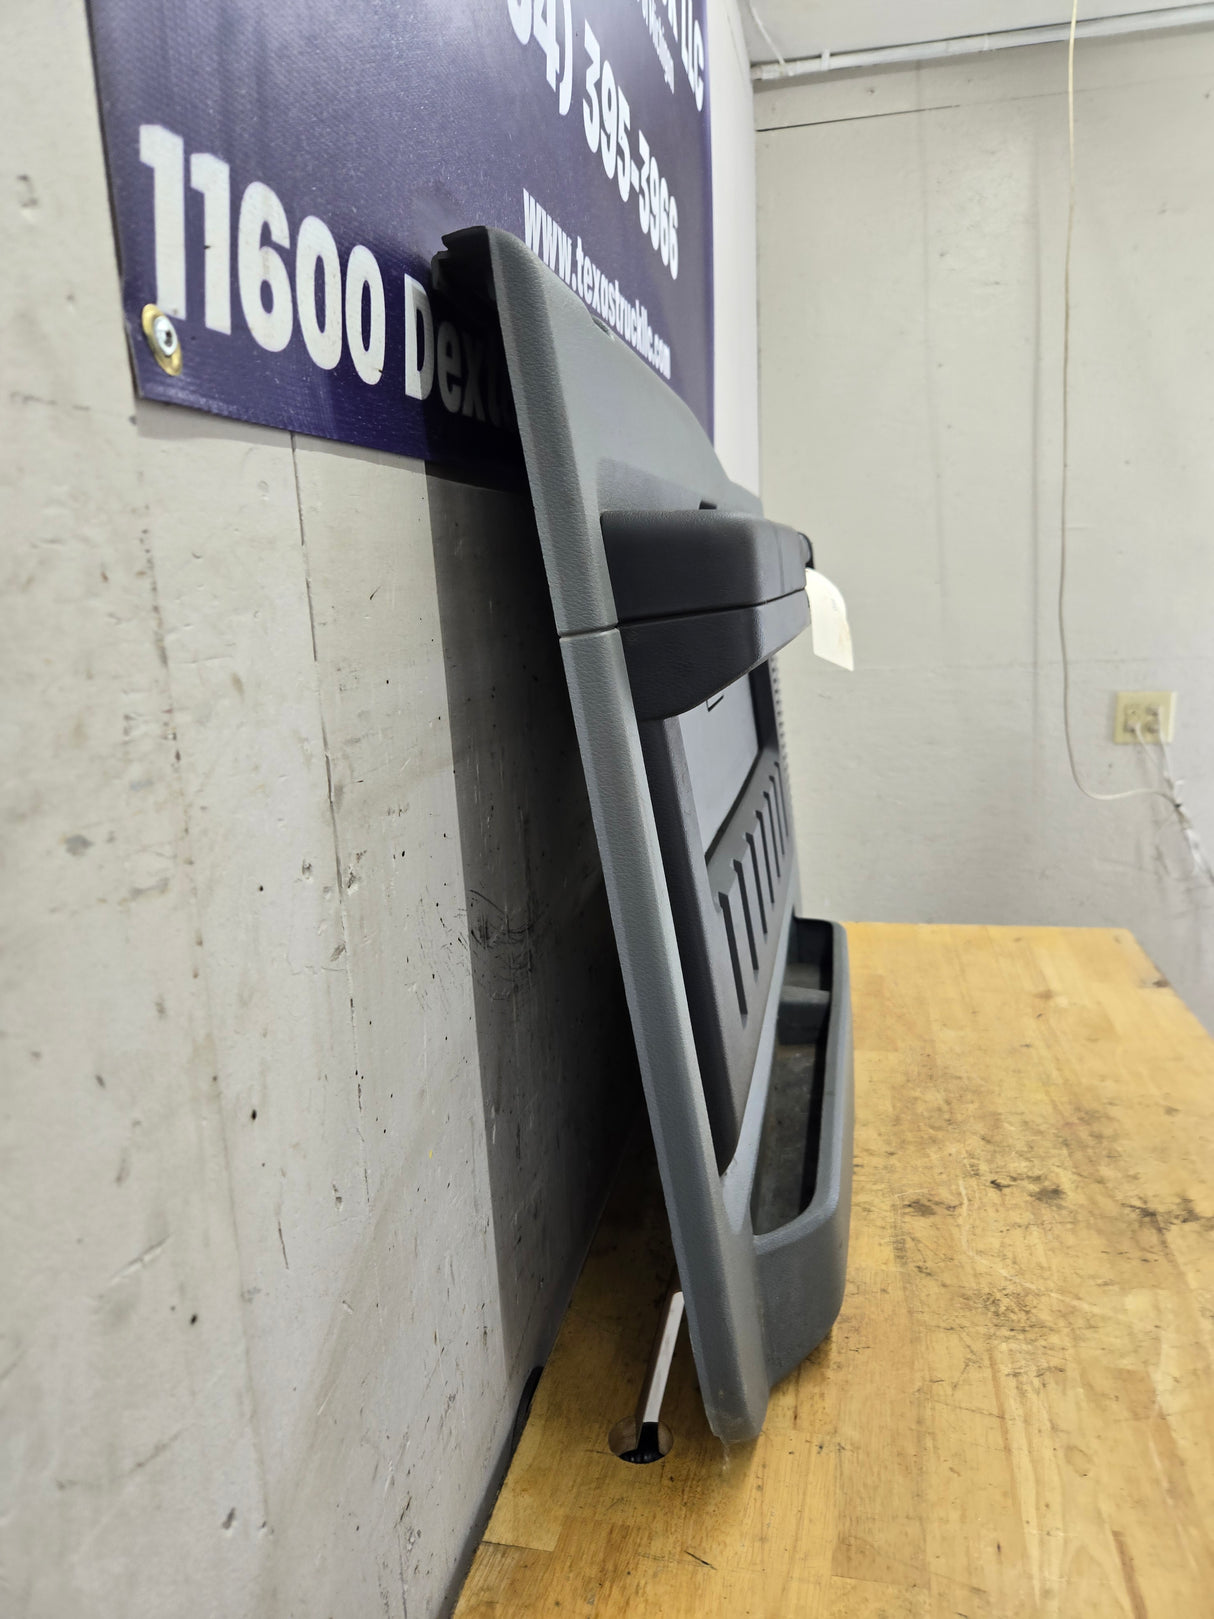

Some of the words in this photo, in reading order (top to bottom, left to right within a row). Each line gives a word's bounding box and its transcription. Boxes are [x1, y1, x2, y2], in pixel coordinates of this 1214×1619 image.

[139, 124, 386, 385] 11600
[507, 0, 573, 116] 4)
[583, 18, 678, 280] 395-3966
